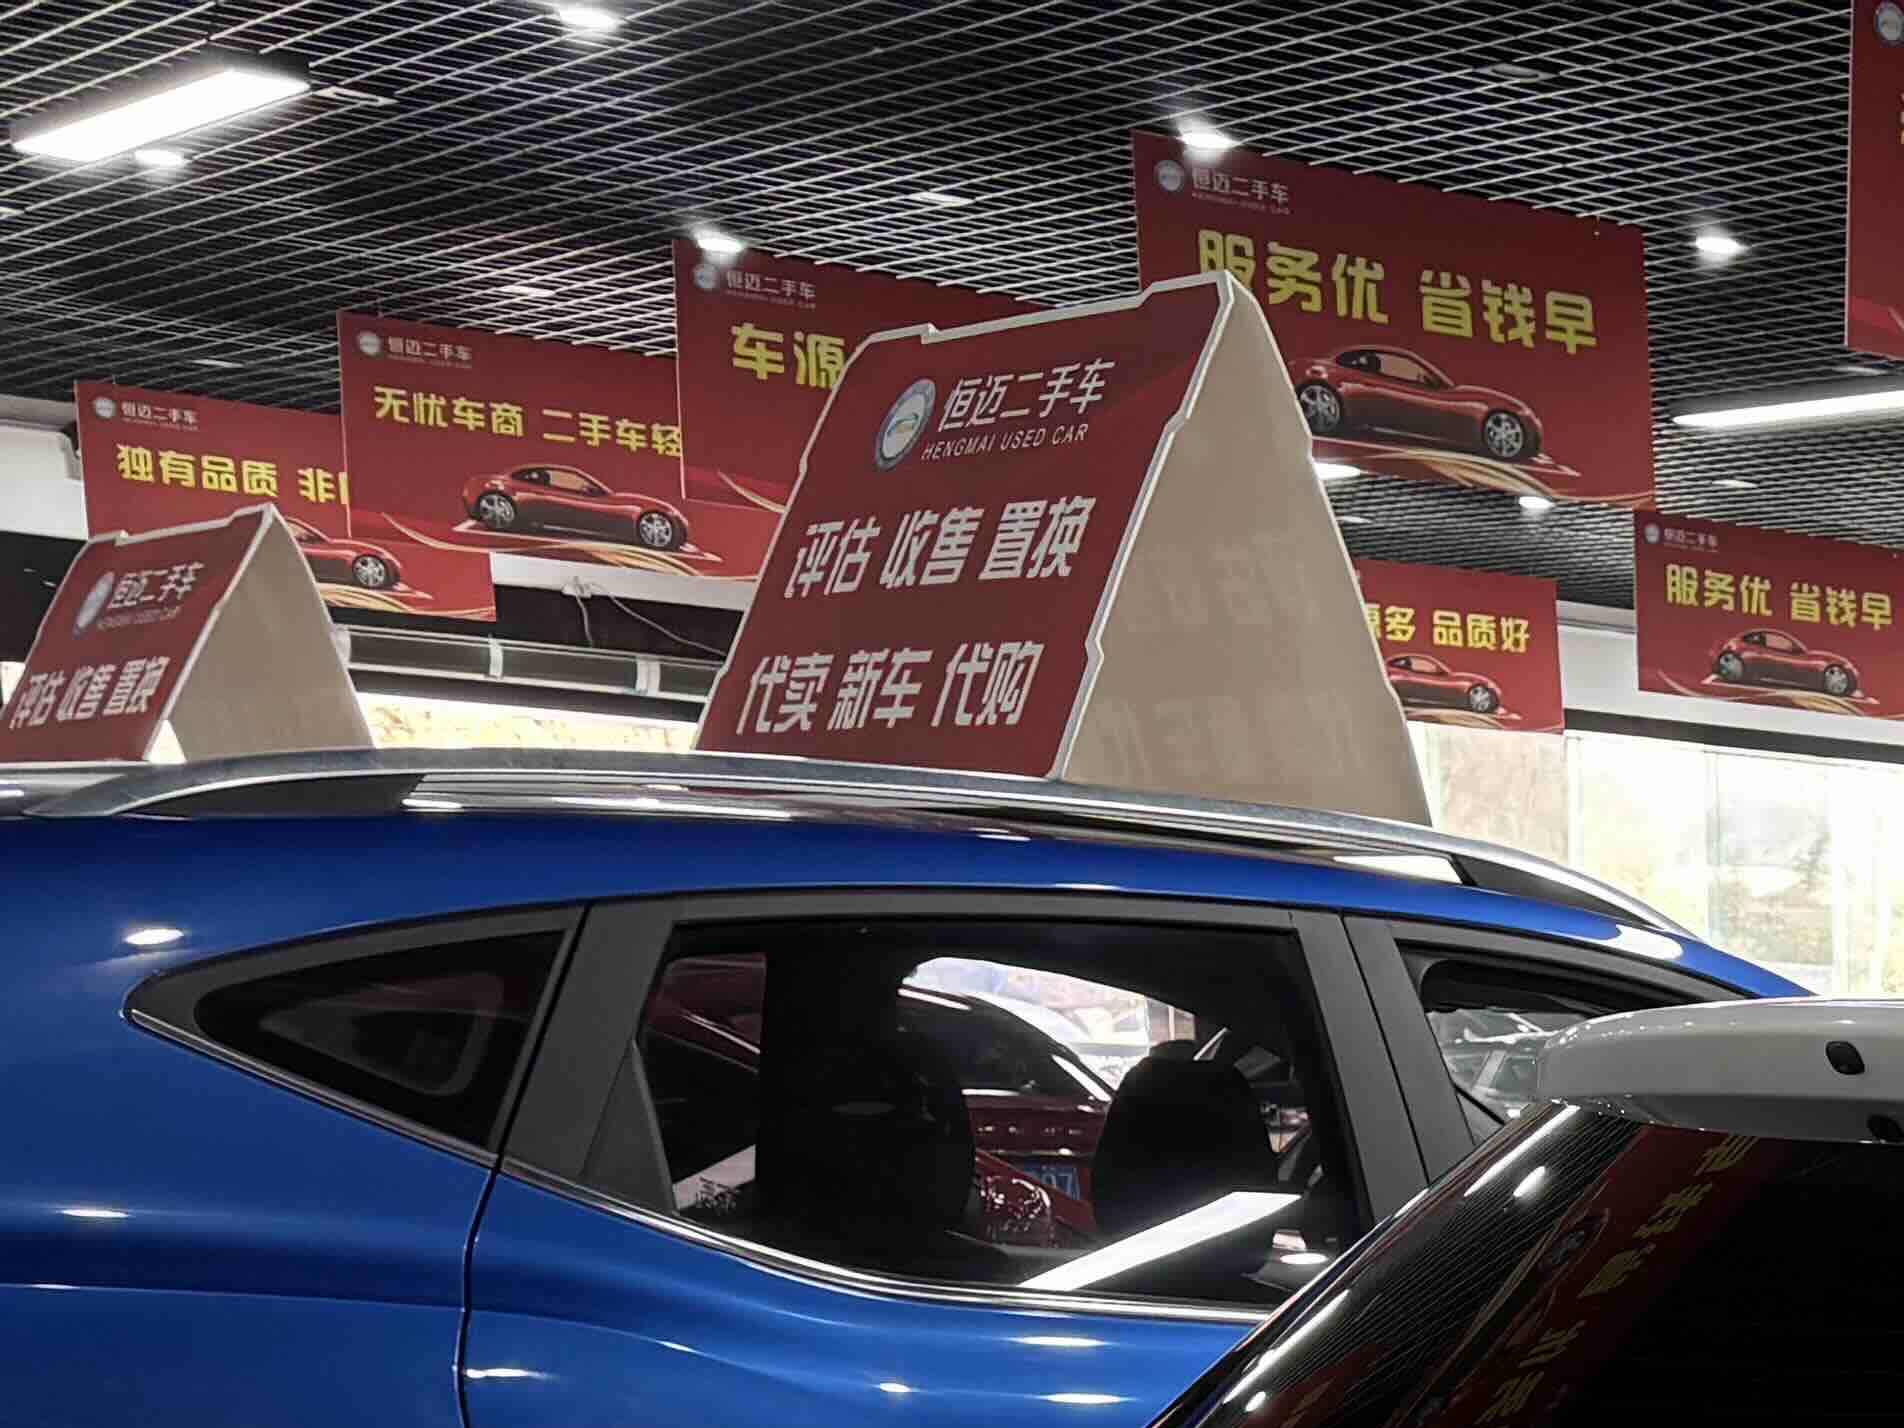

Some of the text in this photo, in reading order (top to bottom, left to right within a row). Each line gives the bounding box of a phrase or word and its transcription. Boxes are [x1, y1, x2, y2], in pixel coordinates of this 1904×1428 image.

[1198, 228, 1598, 354] 服务优 省钱早
[731, 322, 845, 389] 车源
[373, 385, 681, 458] 无忧车商 二手车轻
[938, 358, 1115, 432] 恒迈二手车
[116, 443, 347, 504] 独有品质 非
[921, 423, 1089, 460] HENGMAI USED CAR
[784, 495, 1096, 599] 评估 收售 置换
[1432, 609, 1530, 654] 品质好
[1666, 563, 1894, 631] 服务优 省钱早
[736, 640, 1045, 735] 代卖 新车 代购
